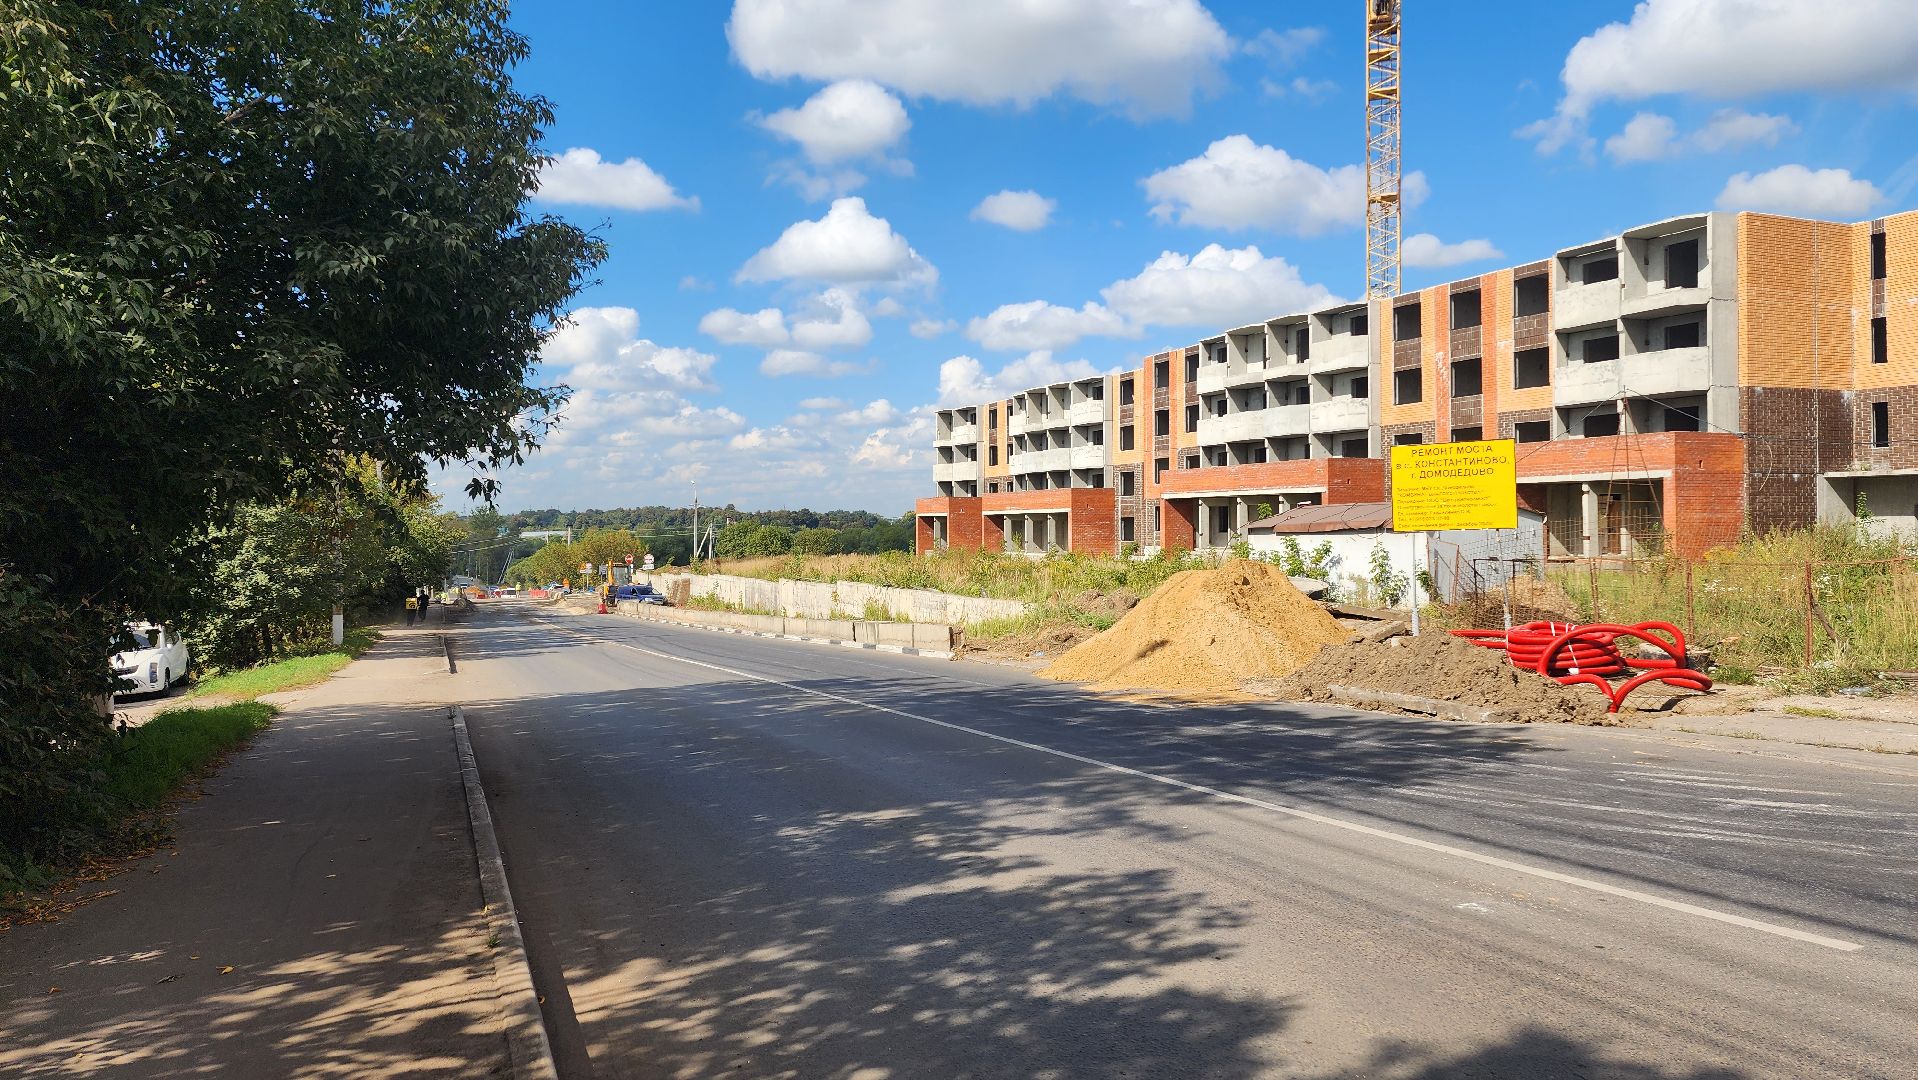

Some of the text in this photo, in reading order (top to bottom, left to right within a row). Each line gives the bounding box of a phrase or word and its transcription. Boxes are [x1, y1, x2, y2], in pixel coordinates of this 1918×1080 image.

[1411, 445, 1492, 457] РЕМОНТ МОСТА
[1419, 467, 1494, 479] ДОМОДЕДОВО
